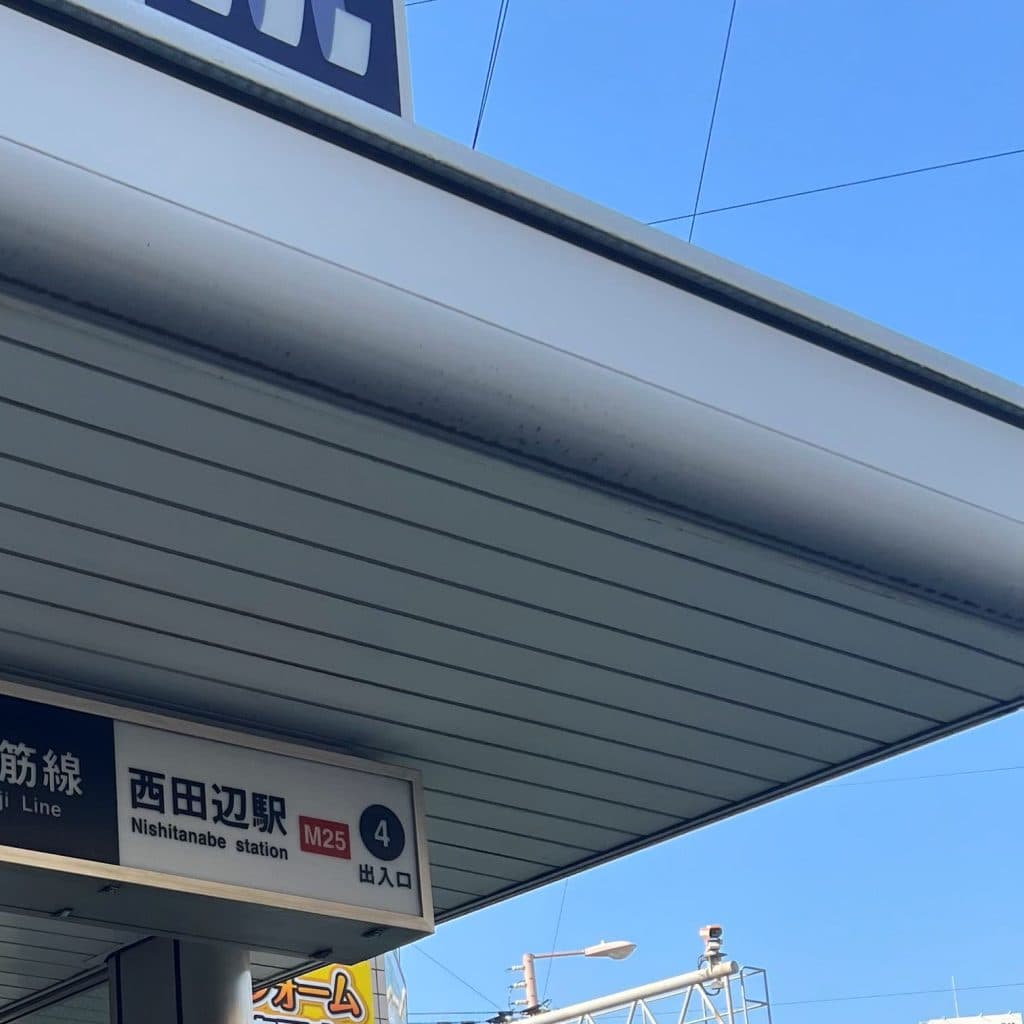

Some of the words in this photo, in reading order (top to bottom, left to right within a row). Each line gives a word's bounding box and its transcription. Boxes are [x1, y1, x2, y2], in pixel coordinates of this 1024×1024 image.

[22, 796, 62, 818] Line
[128, 767, 288, 836] 西田辺駅
[131, 817, 226, 849] Nishitanabe
[236, 839, 289, 861] station
[304, 824, 347, 851] M25
[374, 819, 391, 848] 4
[359, 864, 412, 889] 出入口
[253, 971, 362, 1018] ォーム
